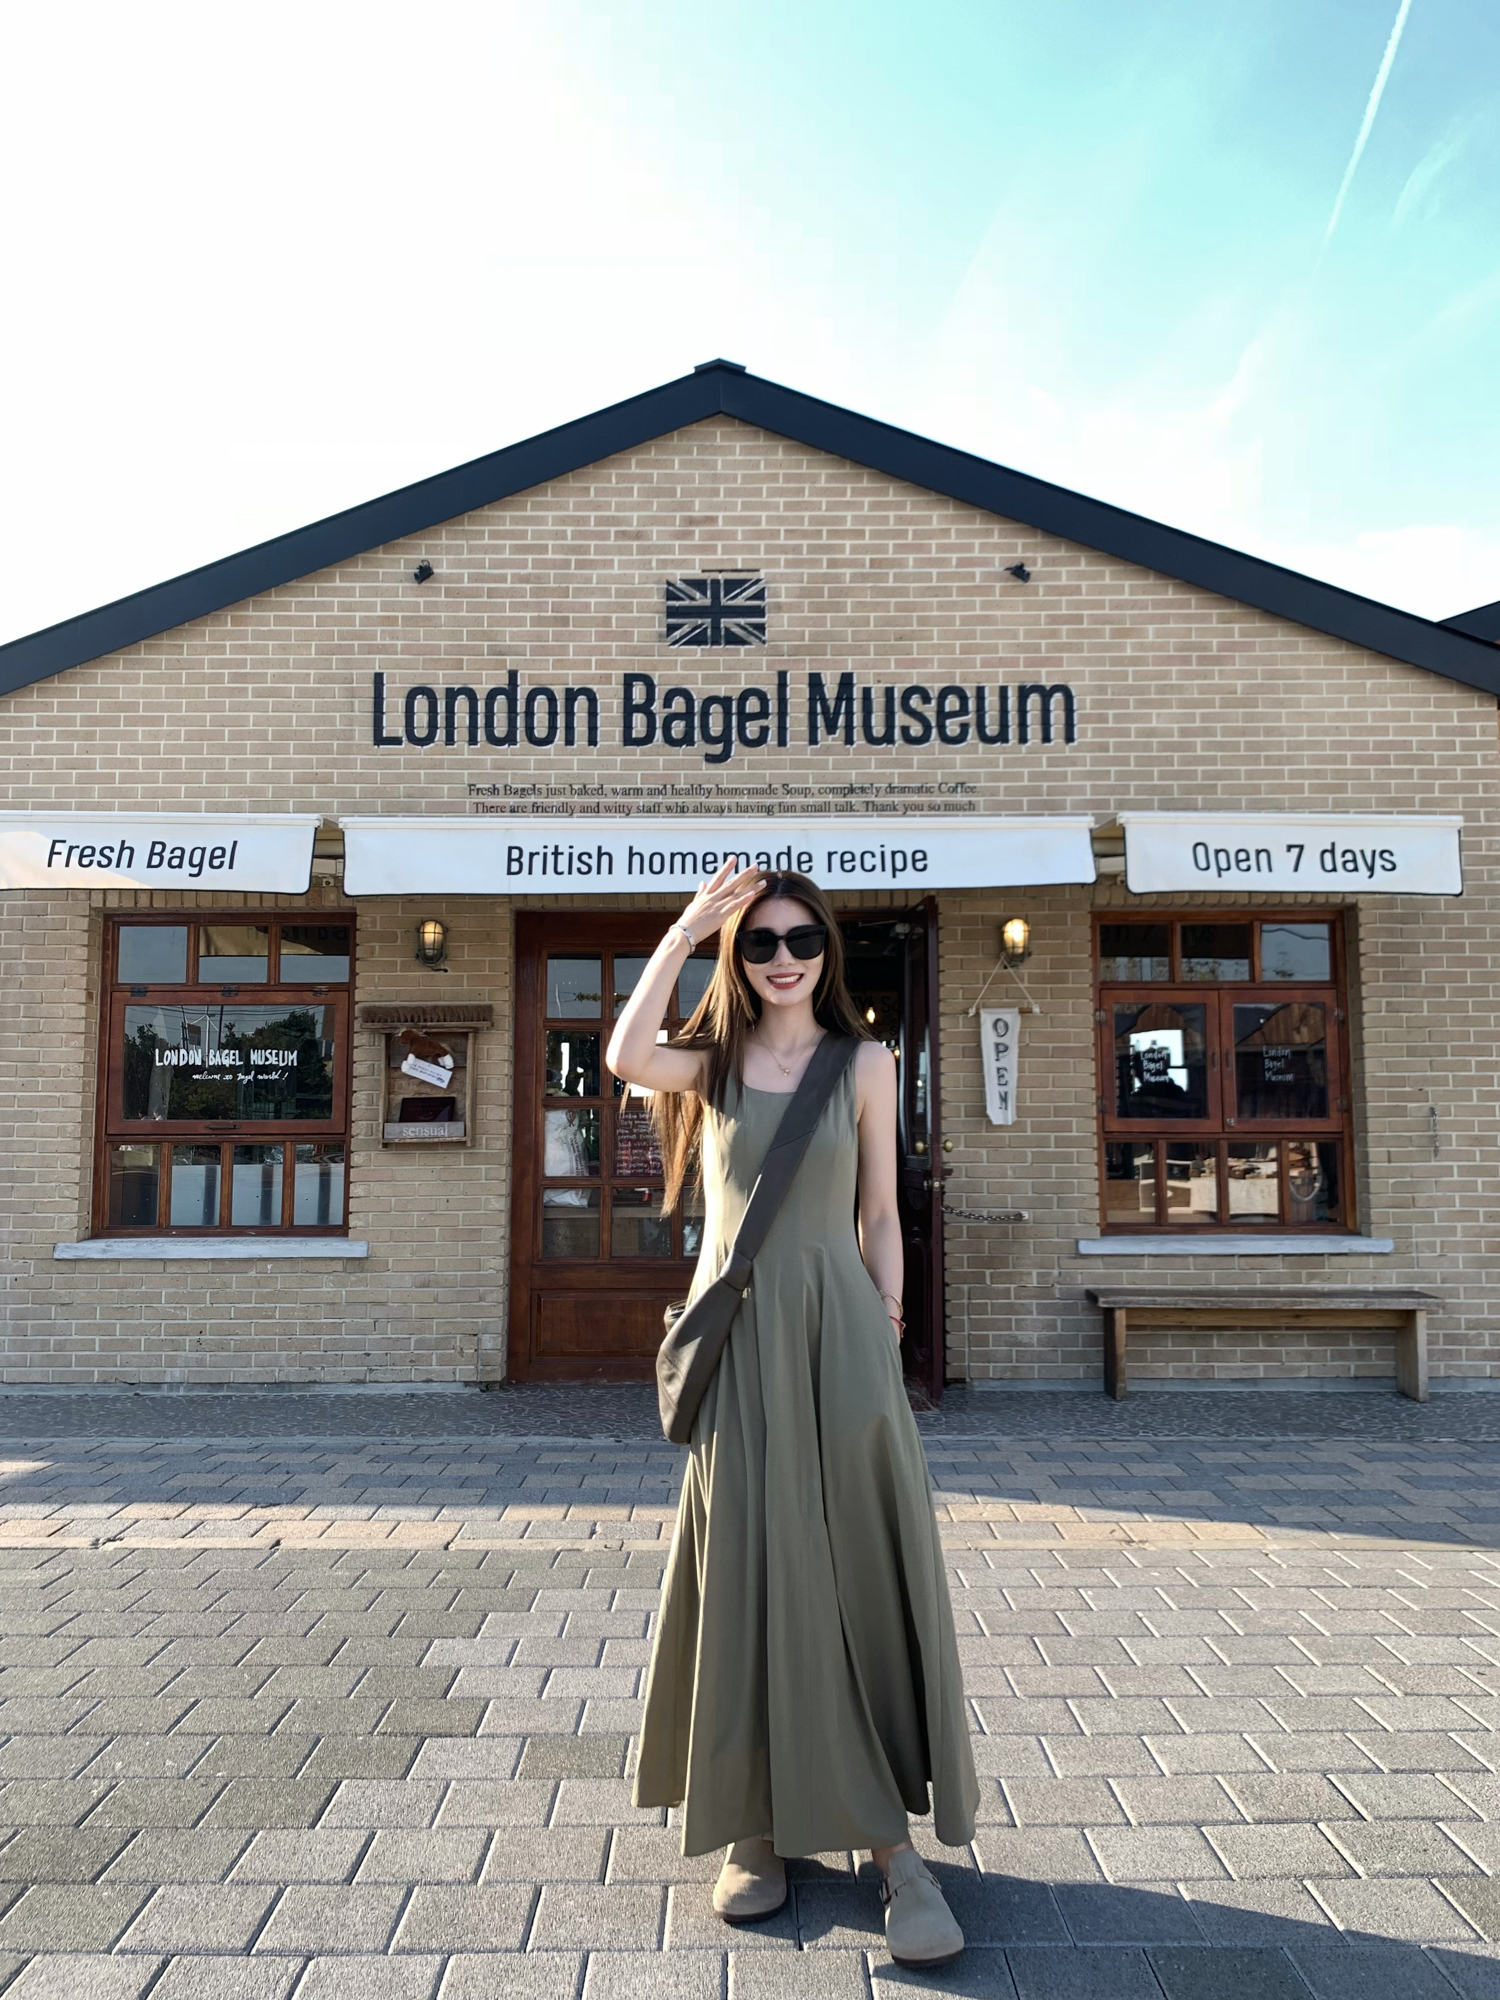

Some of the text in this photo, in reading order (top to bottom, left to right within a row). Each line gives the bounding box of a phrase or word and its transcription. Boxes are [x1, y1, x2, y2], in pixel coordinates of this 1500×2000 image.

[373, 669, 1077, 764] London Bagel Museum
[468, 784, 500, 796] Fresh
[504, 784, 543, 798] Bagels
[545, 785, 567, 798] just
[569, 784, 608, 798] baked,
[611, 787, 643, 797] warm
[646, 784, 667, 797] and
[671, 784, 713, 799] healthy
[715, 784, 778, 796] homemade
[782, 784, 815, 798] Soup,
[818, 783, 881, 798] completely
[884, 783, 935, 795] dramatic
[473, 801, 975, 816] There are friendly and witty staff who always having fun small talk. Thank you so much
[47, 839, 239, 878] Fresh Bagel
[506, 844, 928, 879] British homemade recipe
[1192, 841, 1397, 880] Open 7 days
[155, 1048, 298, 1067] LONDON BAGEL MUSEUM
[992, 1017, 1010, 1111] OPEN
[402, 1123, 448, 1138] sensual
